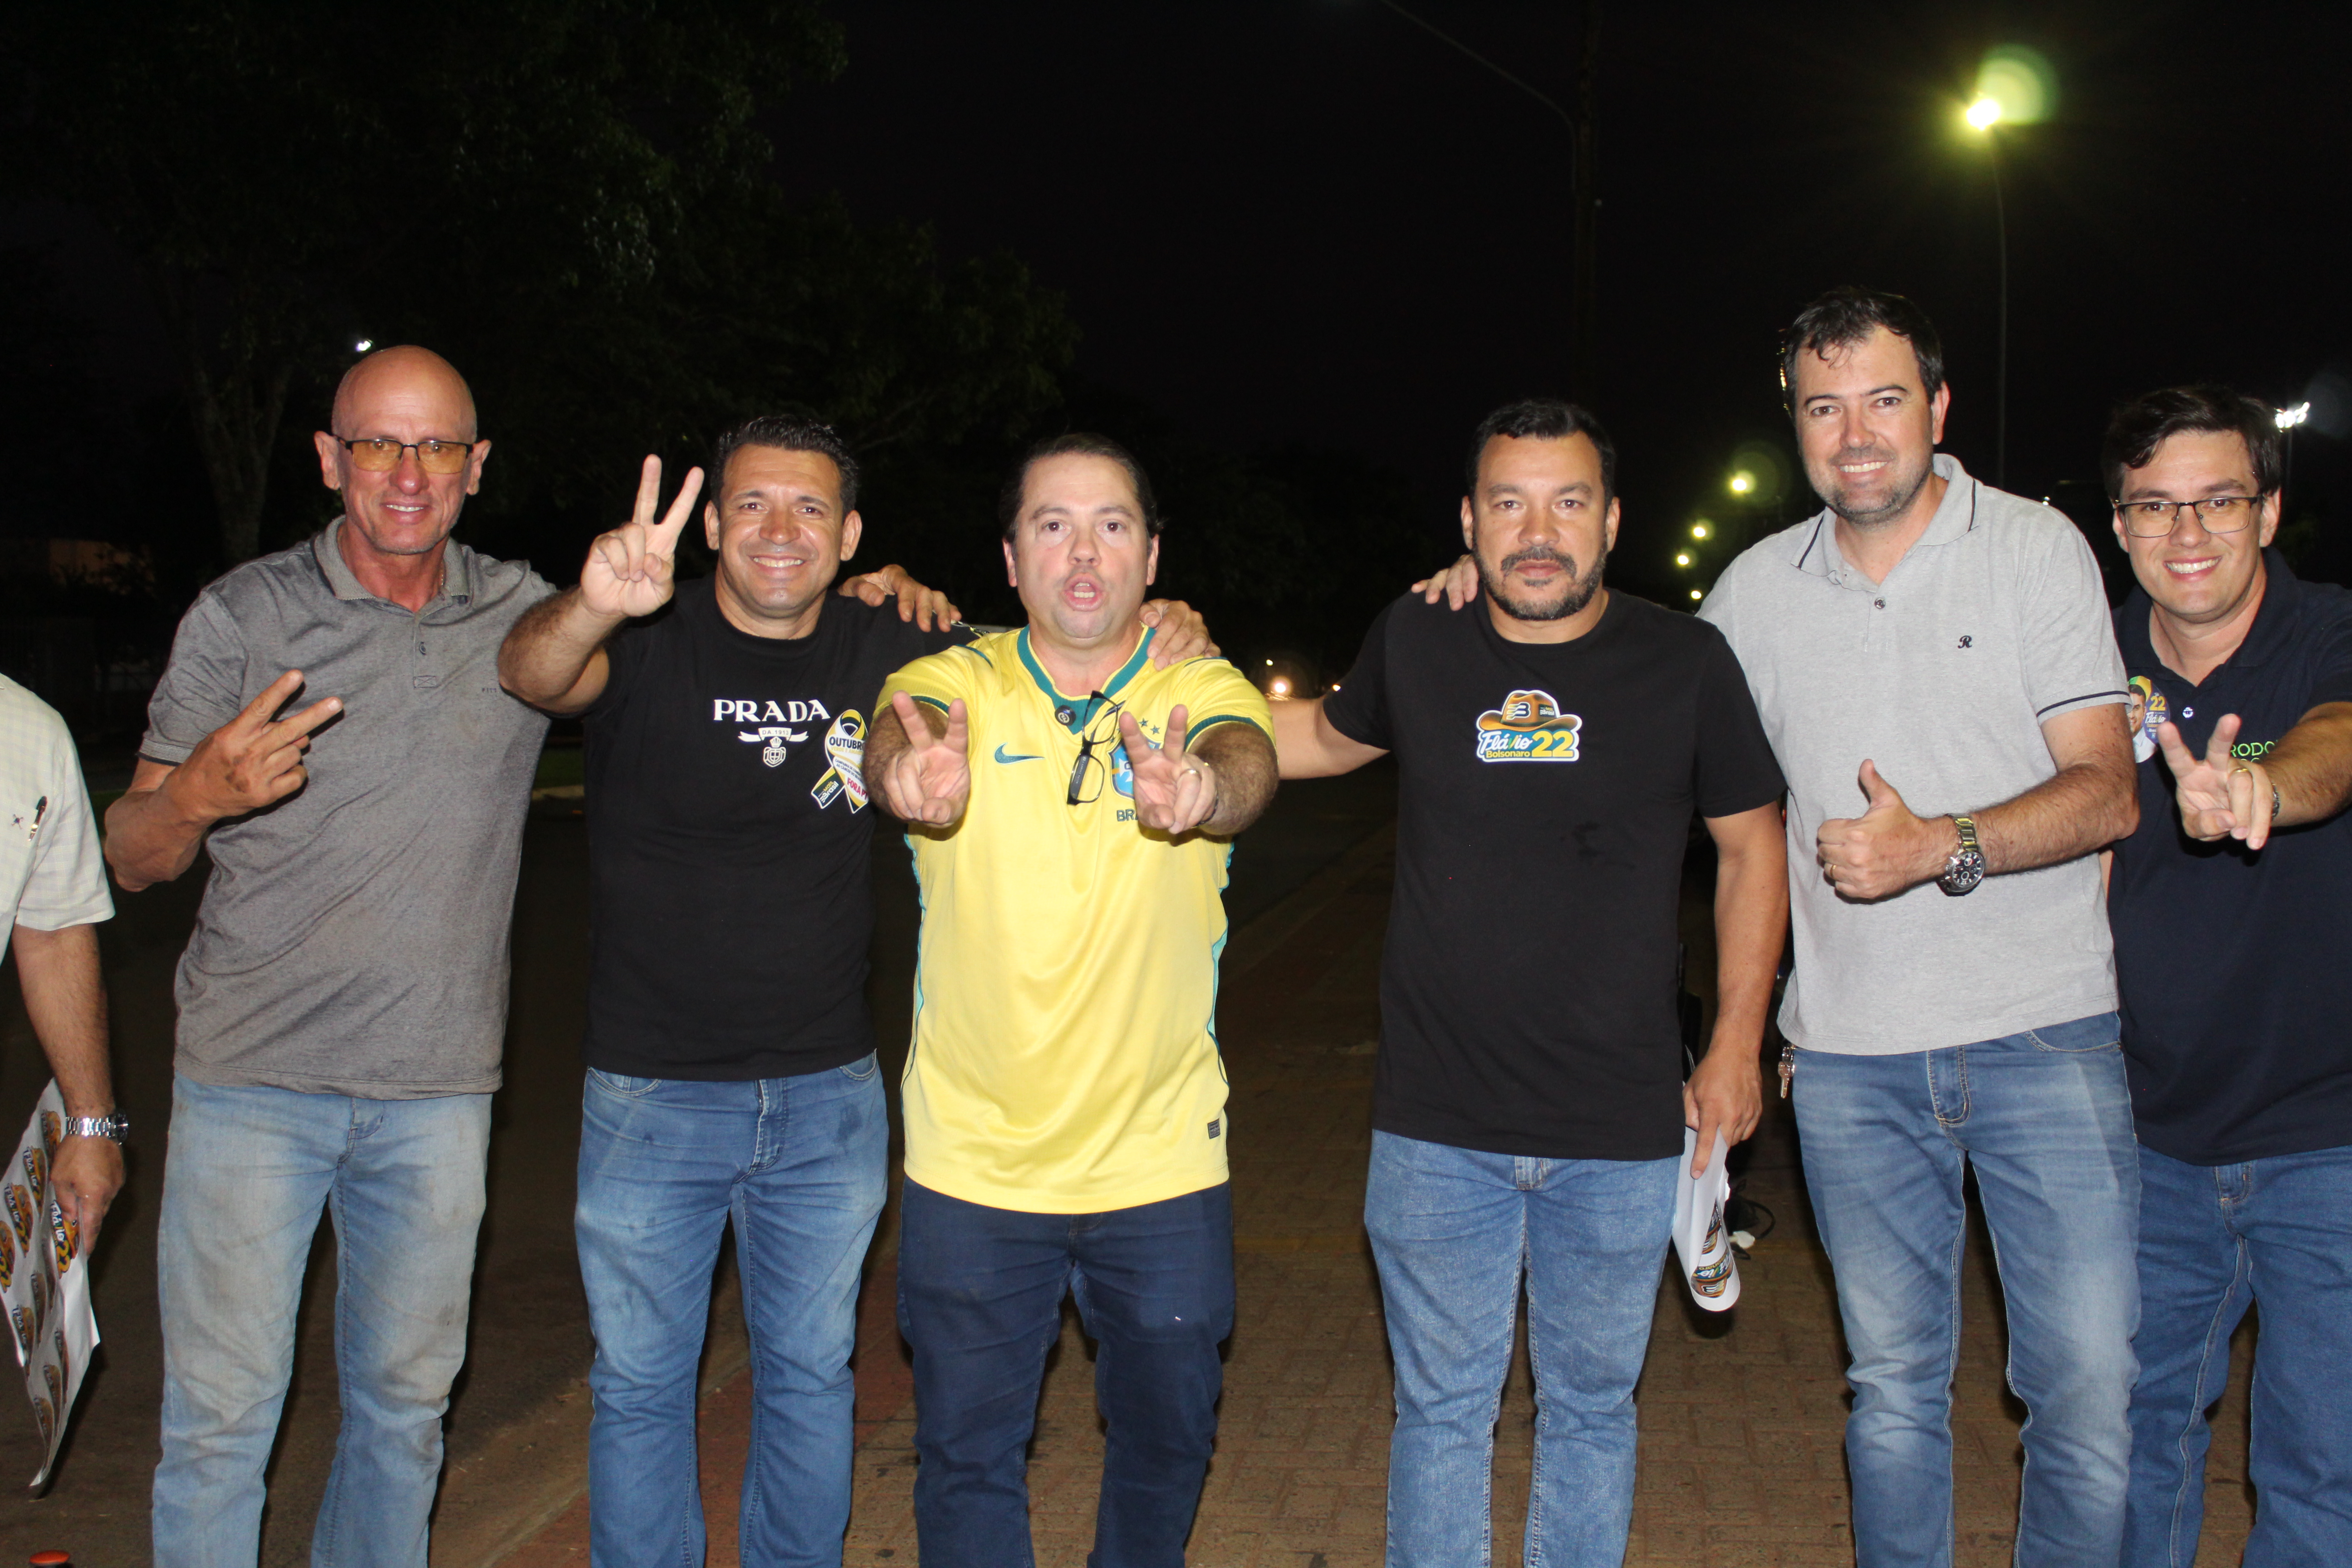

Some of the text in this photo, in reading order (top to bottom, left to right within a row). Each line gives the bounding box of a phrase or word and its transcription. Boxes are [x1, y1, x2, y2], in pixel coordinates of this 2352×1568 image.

[714, 699, 830, 722] PRADA
[2149, 696, 2166, 711] 22
[1480, 730, 1573, 757] Flávio 22
[1486, 750, 1530, 758] Bolsonaro
[847, 777, 862, 796] FORA
